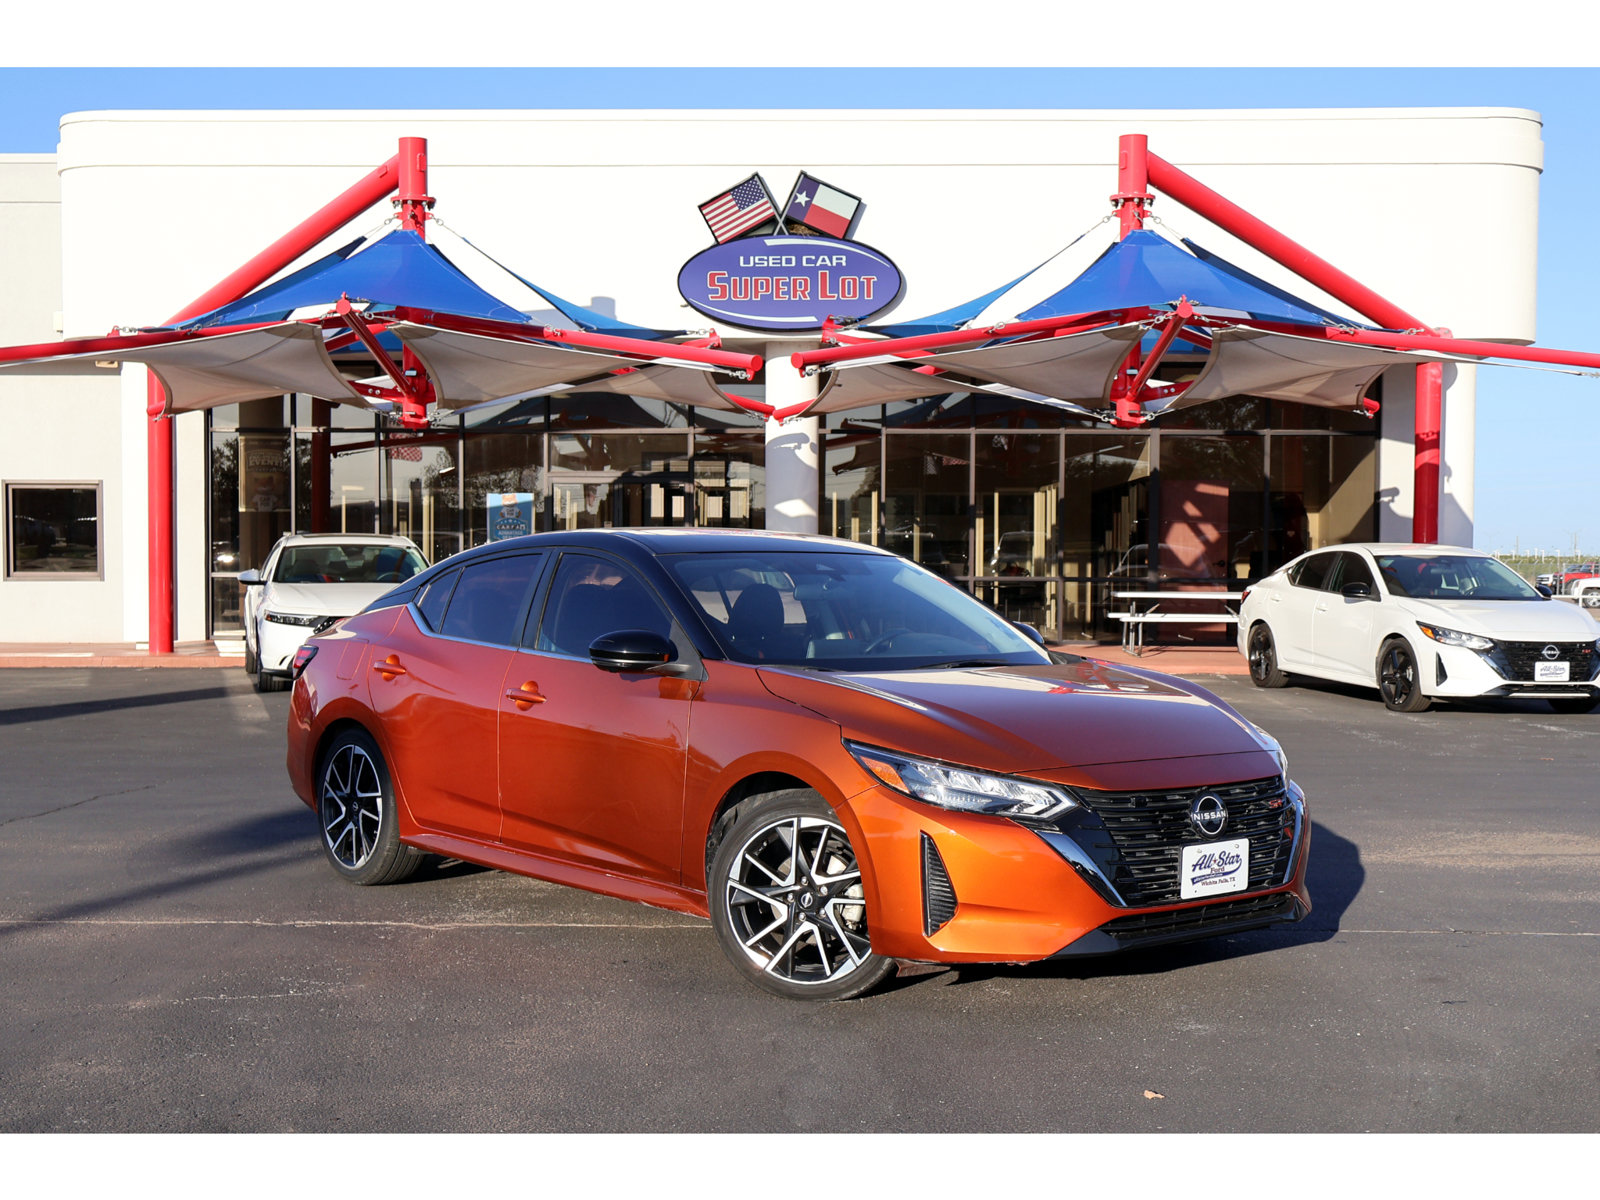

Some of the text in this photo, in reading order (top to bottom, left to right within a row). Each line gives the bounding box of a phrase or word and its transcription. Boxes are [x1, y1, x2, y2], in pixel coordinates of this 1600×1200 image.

[739, 255, 846, 267] USED CAR
[707, 270, 877, 301] SUPER LOT
[1193, 810, 1227, 820] NISSAN
[1192, 850, 1241, 872] All Star
